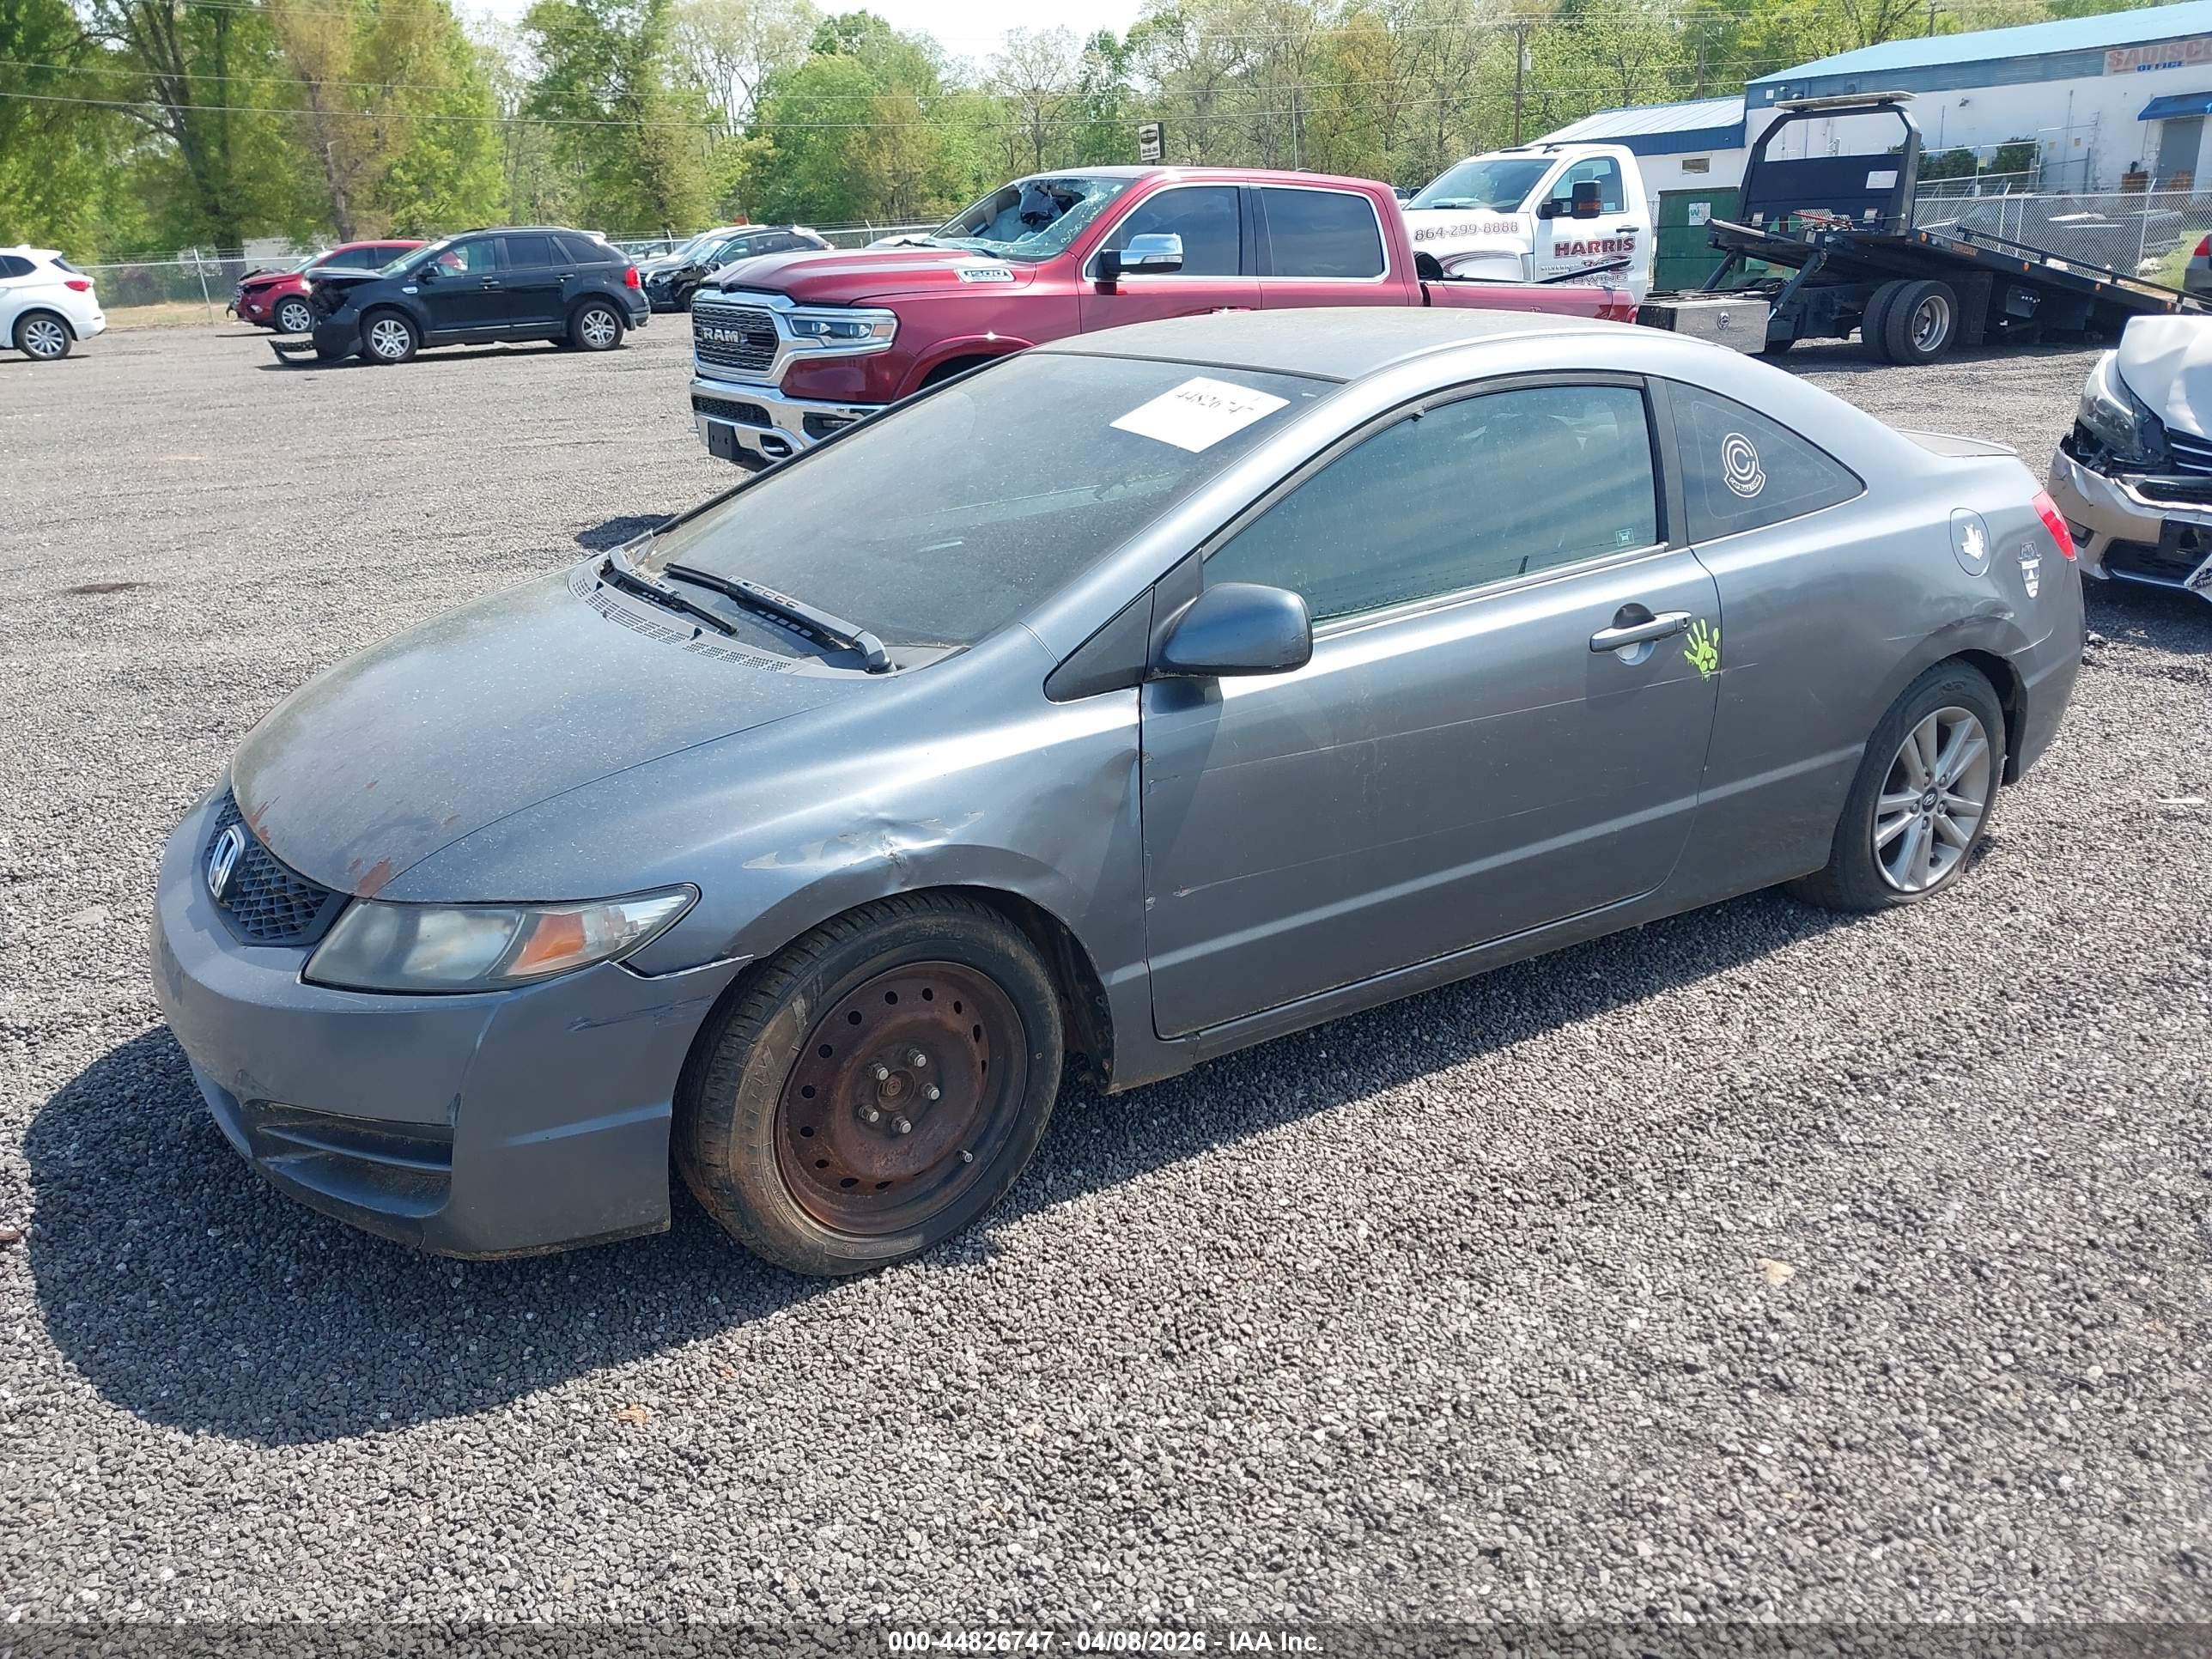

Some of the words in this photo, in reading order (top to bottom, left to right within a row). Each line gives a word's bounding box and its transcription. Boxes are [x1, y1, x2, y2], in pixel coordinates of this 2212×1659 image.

[2136, 60, 2185, 72] OFFICE
[1414, 221, 1519, 242] 864-299-8888
[1553, 236, 1635, 258] HARRIS
[702, 327, 739, 343] RAM
